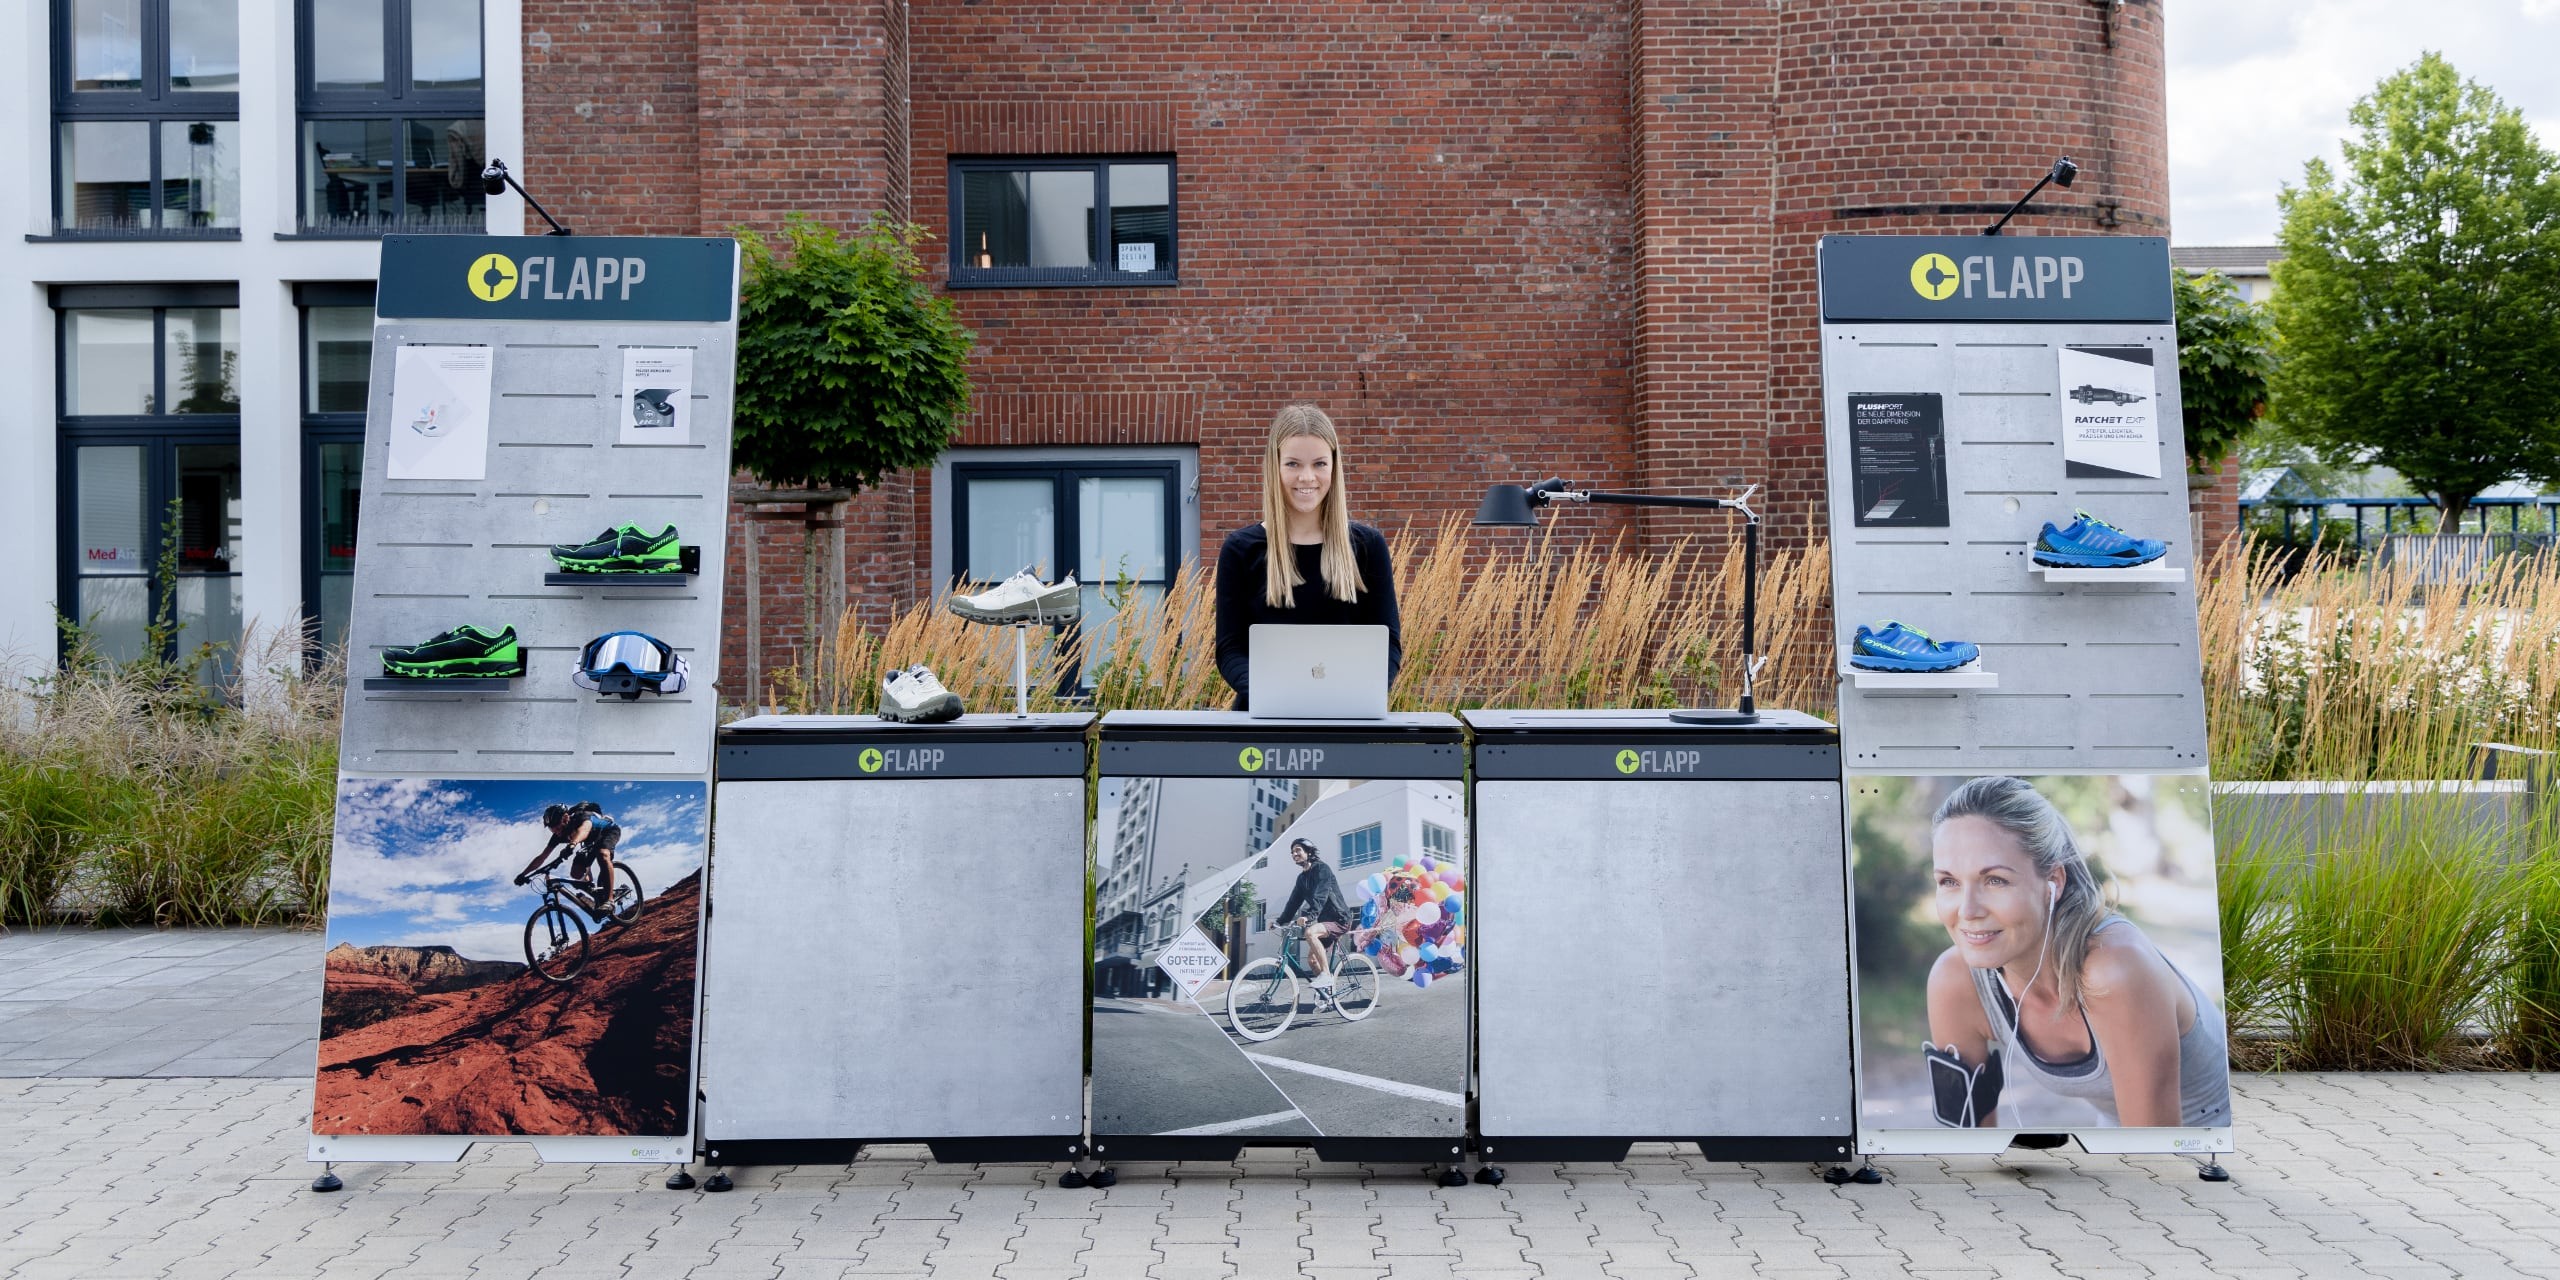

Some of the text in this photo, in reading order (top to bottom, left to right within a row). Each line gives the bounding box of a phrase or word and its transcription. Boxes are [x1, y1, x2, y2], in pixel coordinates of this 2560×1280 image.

[520, 256, 646, 300] FLAPP
[1962, 255, 2084, 299] FLAPP
[1868, 410, 1886, 418] NEUE
[1886, 410, 1921, 418] DIMENSION
[2074, 416, 2123, 424] RATCHET
[646, 534, 675, 553] DYNAFIT
[88, 547, 138, 561] MedAix
[1863, 638, 1909, 656] DYNAFIT
[883, 748, 945, 772] FLAPP
[1264, 748, 1325, 771] FLAPP
[1640, 750, 1701, 773] FLAPP
[1167, 955, 1218, 966] GORE-TEX
